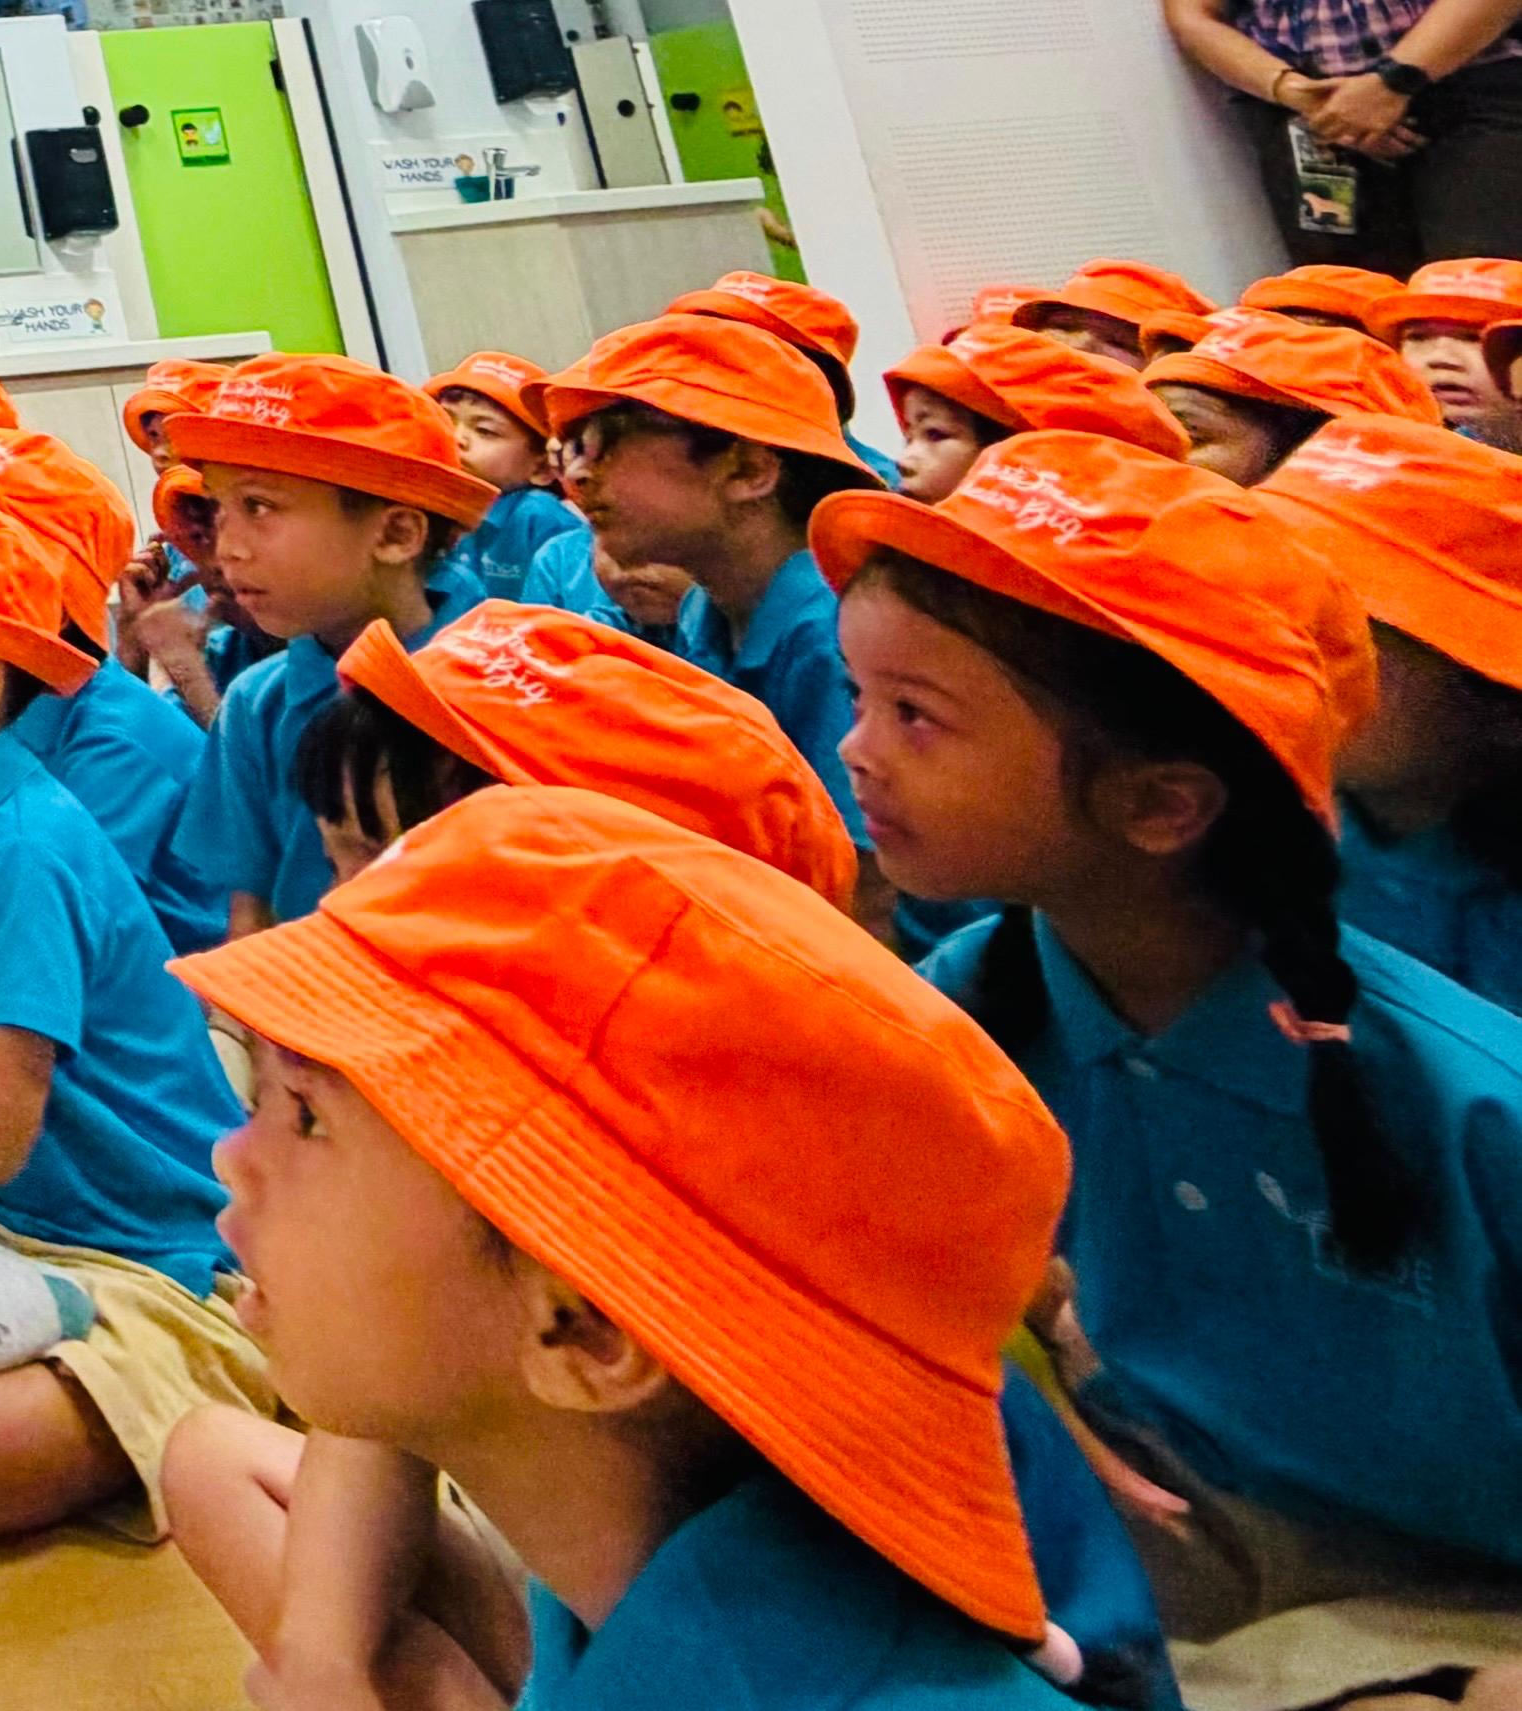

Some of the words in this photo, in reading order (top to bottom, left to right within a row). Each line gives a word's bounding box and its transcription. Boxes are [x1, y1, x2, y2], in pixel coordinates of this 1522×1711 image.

[423, 156, 456, 169] YOUR
[399, 170, 444, 183] HANDS
[48, 303, 84, 318] YOUR
[25, 318, 71, 334] HANDS
